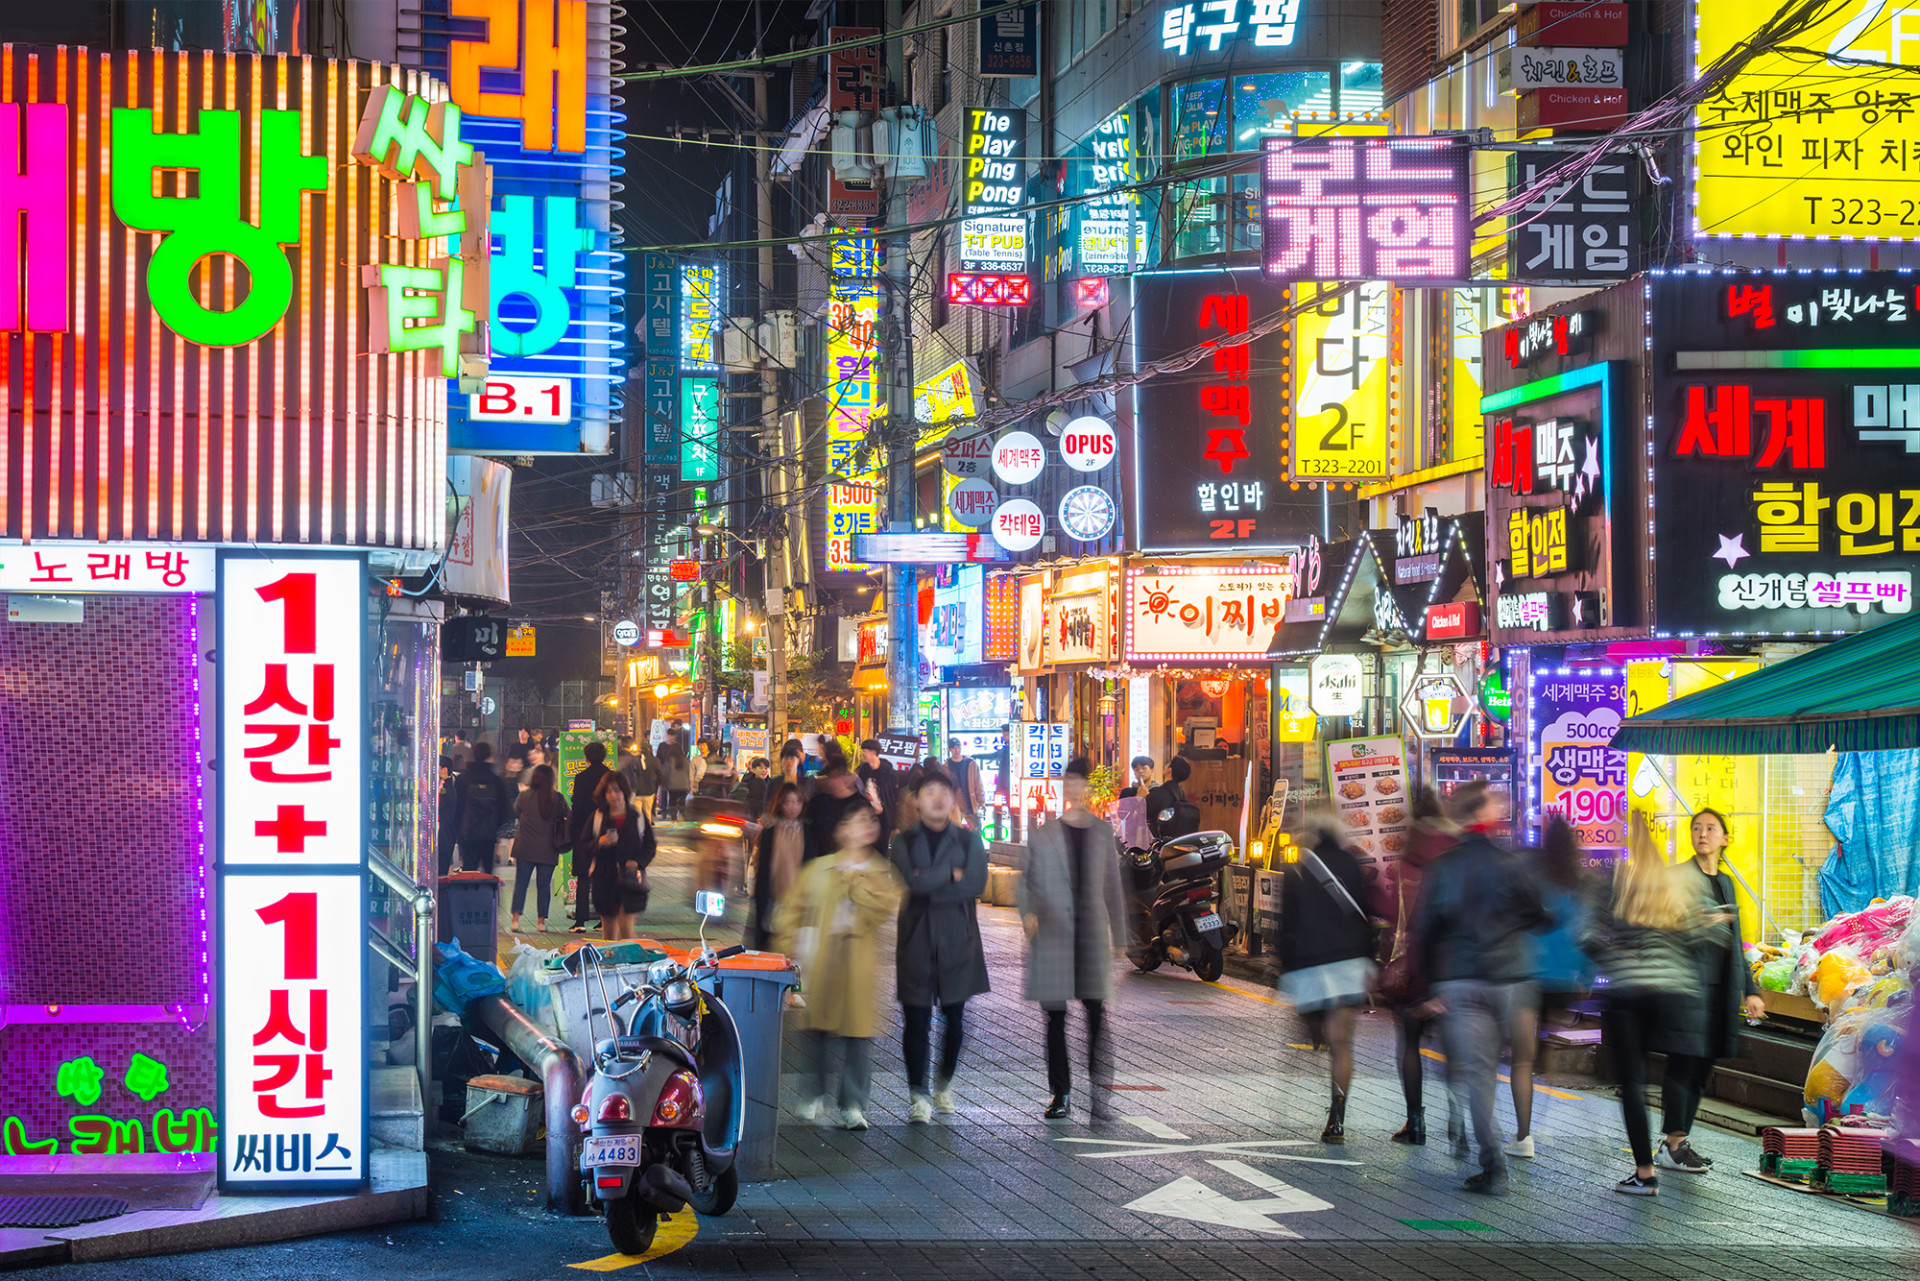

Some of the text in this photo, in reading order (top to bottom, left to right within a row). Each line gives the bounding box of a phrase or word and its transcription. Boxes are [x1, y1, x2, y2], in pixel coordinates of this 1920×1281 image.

[1549, 8, 1591, 19] Chicken
[1604, 9, 1622, 20] Hof
[1549, 94, 1591, 104] Chicken
[1604, 94, 1622, 105] Hof
[1708, 89, 1915, 124] 수제맥주 양주
[971, 110, 1010, 132] The
[969, 134, 1016, 158] Play
[1722, 134, 1783, 168] 와인
[1801, 137, 1864, 170] 피자
[968, 158, 1016, 181] Ping
[1267, 139, 1457, 207] 보드
[968, 181, 1021, 205] Pong
[1525, 164, 1630, 213] 보드
[1804, 197, 1920, 226] T 323-2
[964, 220, 1024, 235] Signature
[965, 234, 1024, 250] T-T PUB
[1269, 207, 1454, 276] 게임
[1525, 224, 1629, 271] 게임
[648, 257, 676, 269] J&J
[964, 249, 1023, 261] (Table Tennis)
[963, 262, 1023, 272] 3F 336-6537
[652, 274, 672, 337] 고시텔
[1728, 284, 1907, 329] 별이 빛나는
[689, 281, 711, 360] 인도요리
[648, 364, 676, 377] J&J
[478, 383, 563, 417] B.1
[1319, 402, 1366, 451] 2F
[1676, 385, 1825, 468] 세계
[945, 436, 991, 459] 오퍼스
[1065, 434, 1113, 455] OPUS
[958, 461, 977, 473] 2층
[998, 449, 1041, 468] 세계맥주
[1086, 458, 1096, 467] 2F
[1313, 459, 1382, 474] 323-2201
[1493, 419, 1575, 496] 세계 맥주
[695, 467, 705, 477] 1F
[832, 481, 872, 505] 1,900
[954, 490, 996, 514] 세계맥주
[1198, 481, 1263, 511] 할인바
[833, 512, 871, 535] 호가든
[1000, 513, 1041, 537] 칵테일
[1210, 519, 1257, 539] 2F
[1509, 505, 1568, 578] 할인점
[29, 551, 190, 588] 노래방
[1218, 582, 1253, 593] 스토리가
[1731, 579, 1908, 604] 신개념 셀프빠
[1432, 616, 1448, 628] Chicken
[1452, 614, 1460, 626] Hof
[243, 572, 343, 784] 1시간
[1319, 673, 1357, 688] Asahi
[1332, 692, 1342, 700] 生
[1541, 683, 1606, 703] 세계맥주
[1289, 720, 1299, 732] 生
[1566, 723, 1616, 739] 500cc
[1029, 725, 1045, 777] 칵테일
[371, 761, 403, 773] RRA
[1549, 746, 1625, 783] 생맥주
[371, 829, 403, 841] RRA
[252, 892, 333, 1119] 1시간
[233, 1133, 353, 1173] 써비스
[598, 1147, 637, 1162] 4483
